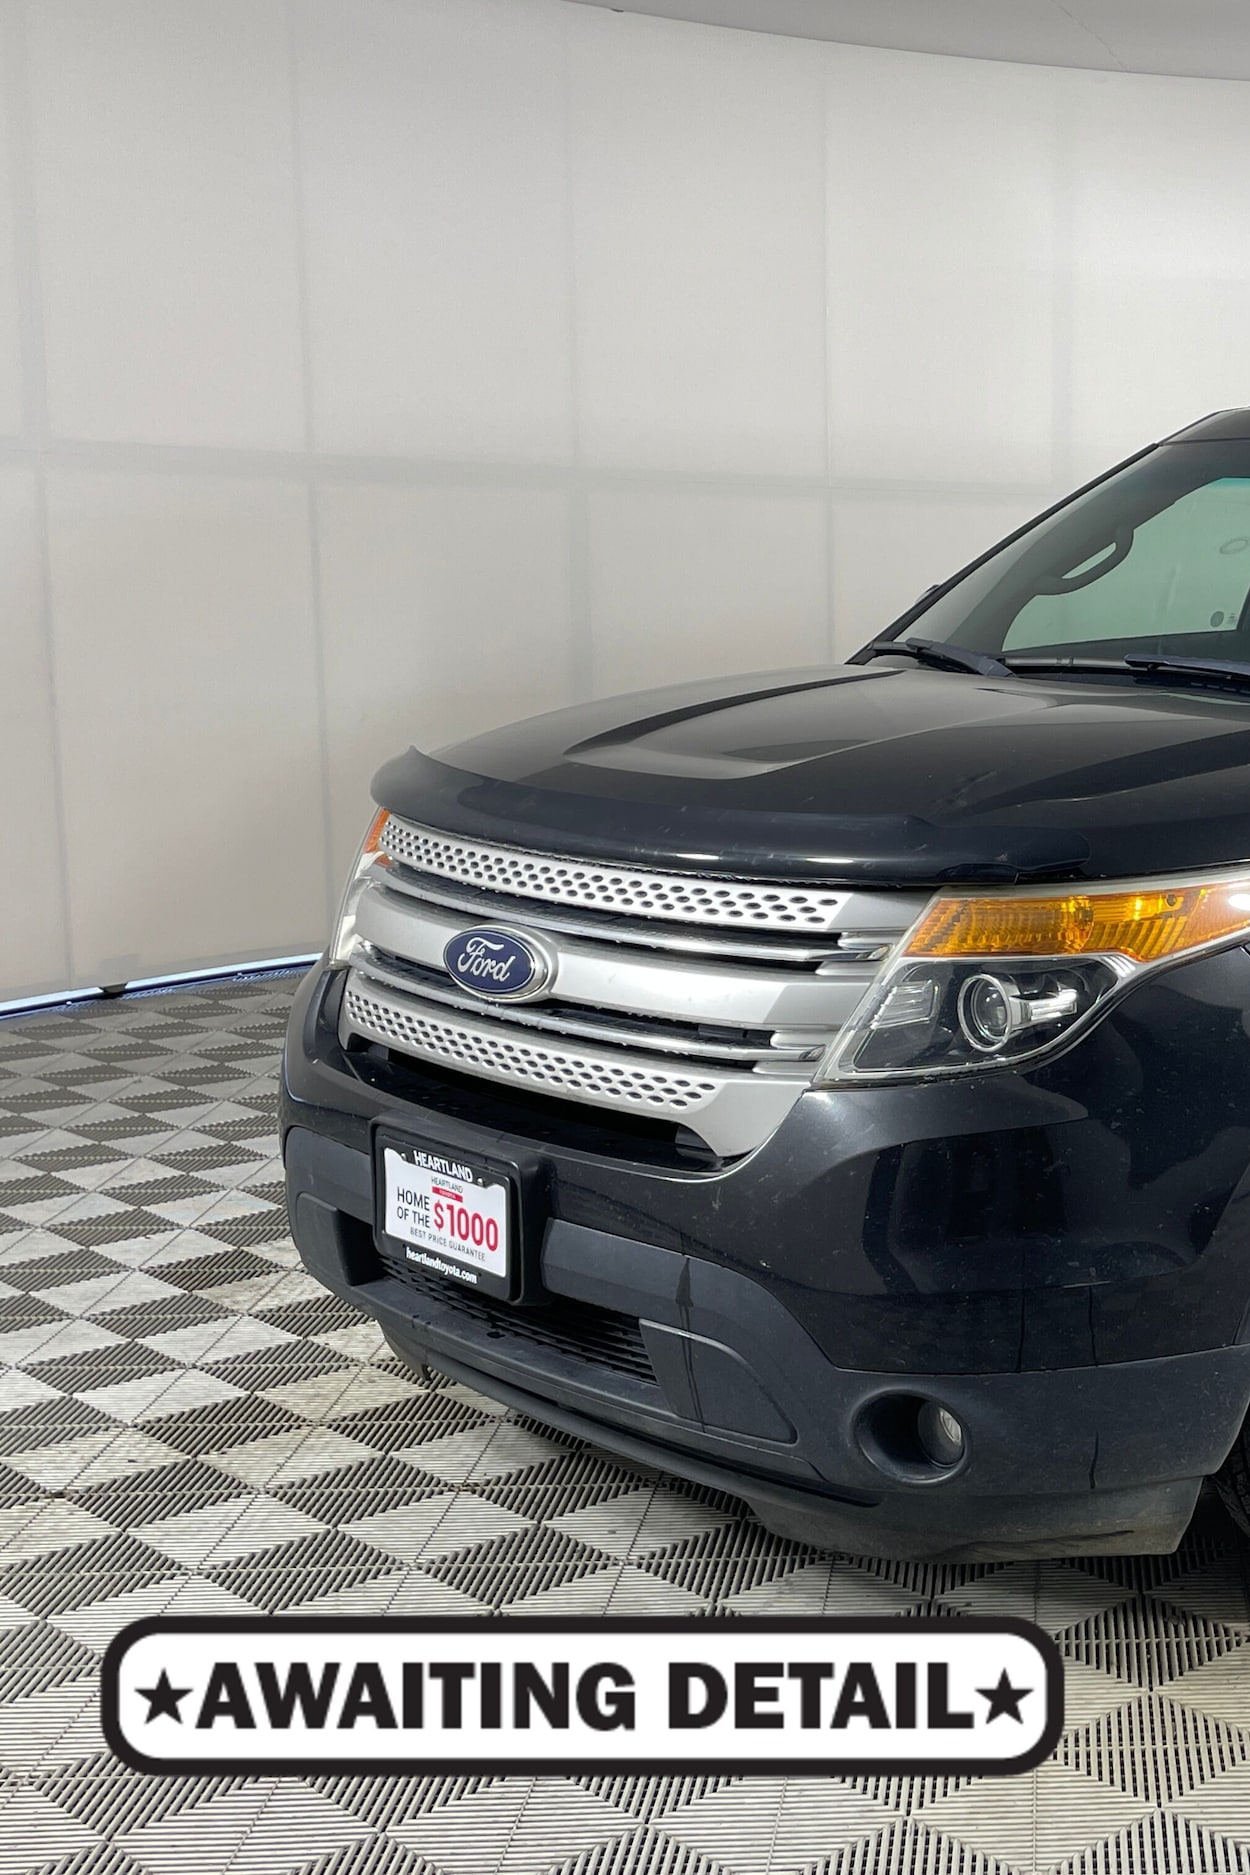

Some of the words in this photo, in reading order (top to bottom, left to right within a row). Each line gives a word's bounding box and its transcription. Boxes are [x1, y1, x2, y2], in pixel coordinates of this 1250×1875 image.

[457, 936, 516, 982] Ford
[413, 1150, 473, 1183] HEARTLAND
[396, 1186, 430, 1211] HOME
[431, 1175, 463, 1194] HEARTLAND
[396, 1206, 409, 1220] OF
[413, 1210, 430, 1229] THE
[434, 1200, 499, 1252] $1000
[410, 1227, 426, 1239] BEST
[428, 1232, 447, 1248] PRICE
[449, 1238, 486, 1262] GUARANTEE
[406, 1247, 478, 1285] heartlandtoyota.com
